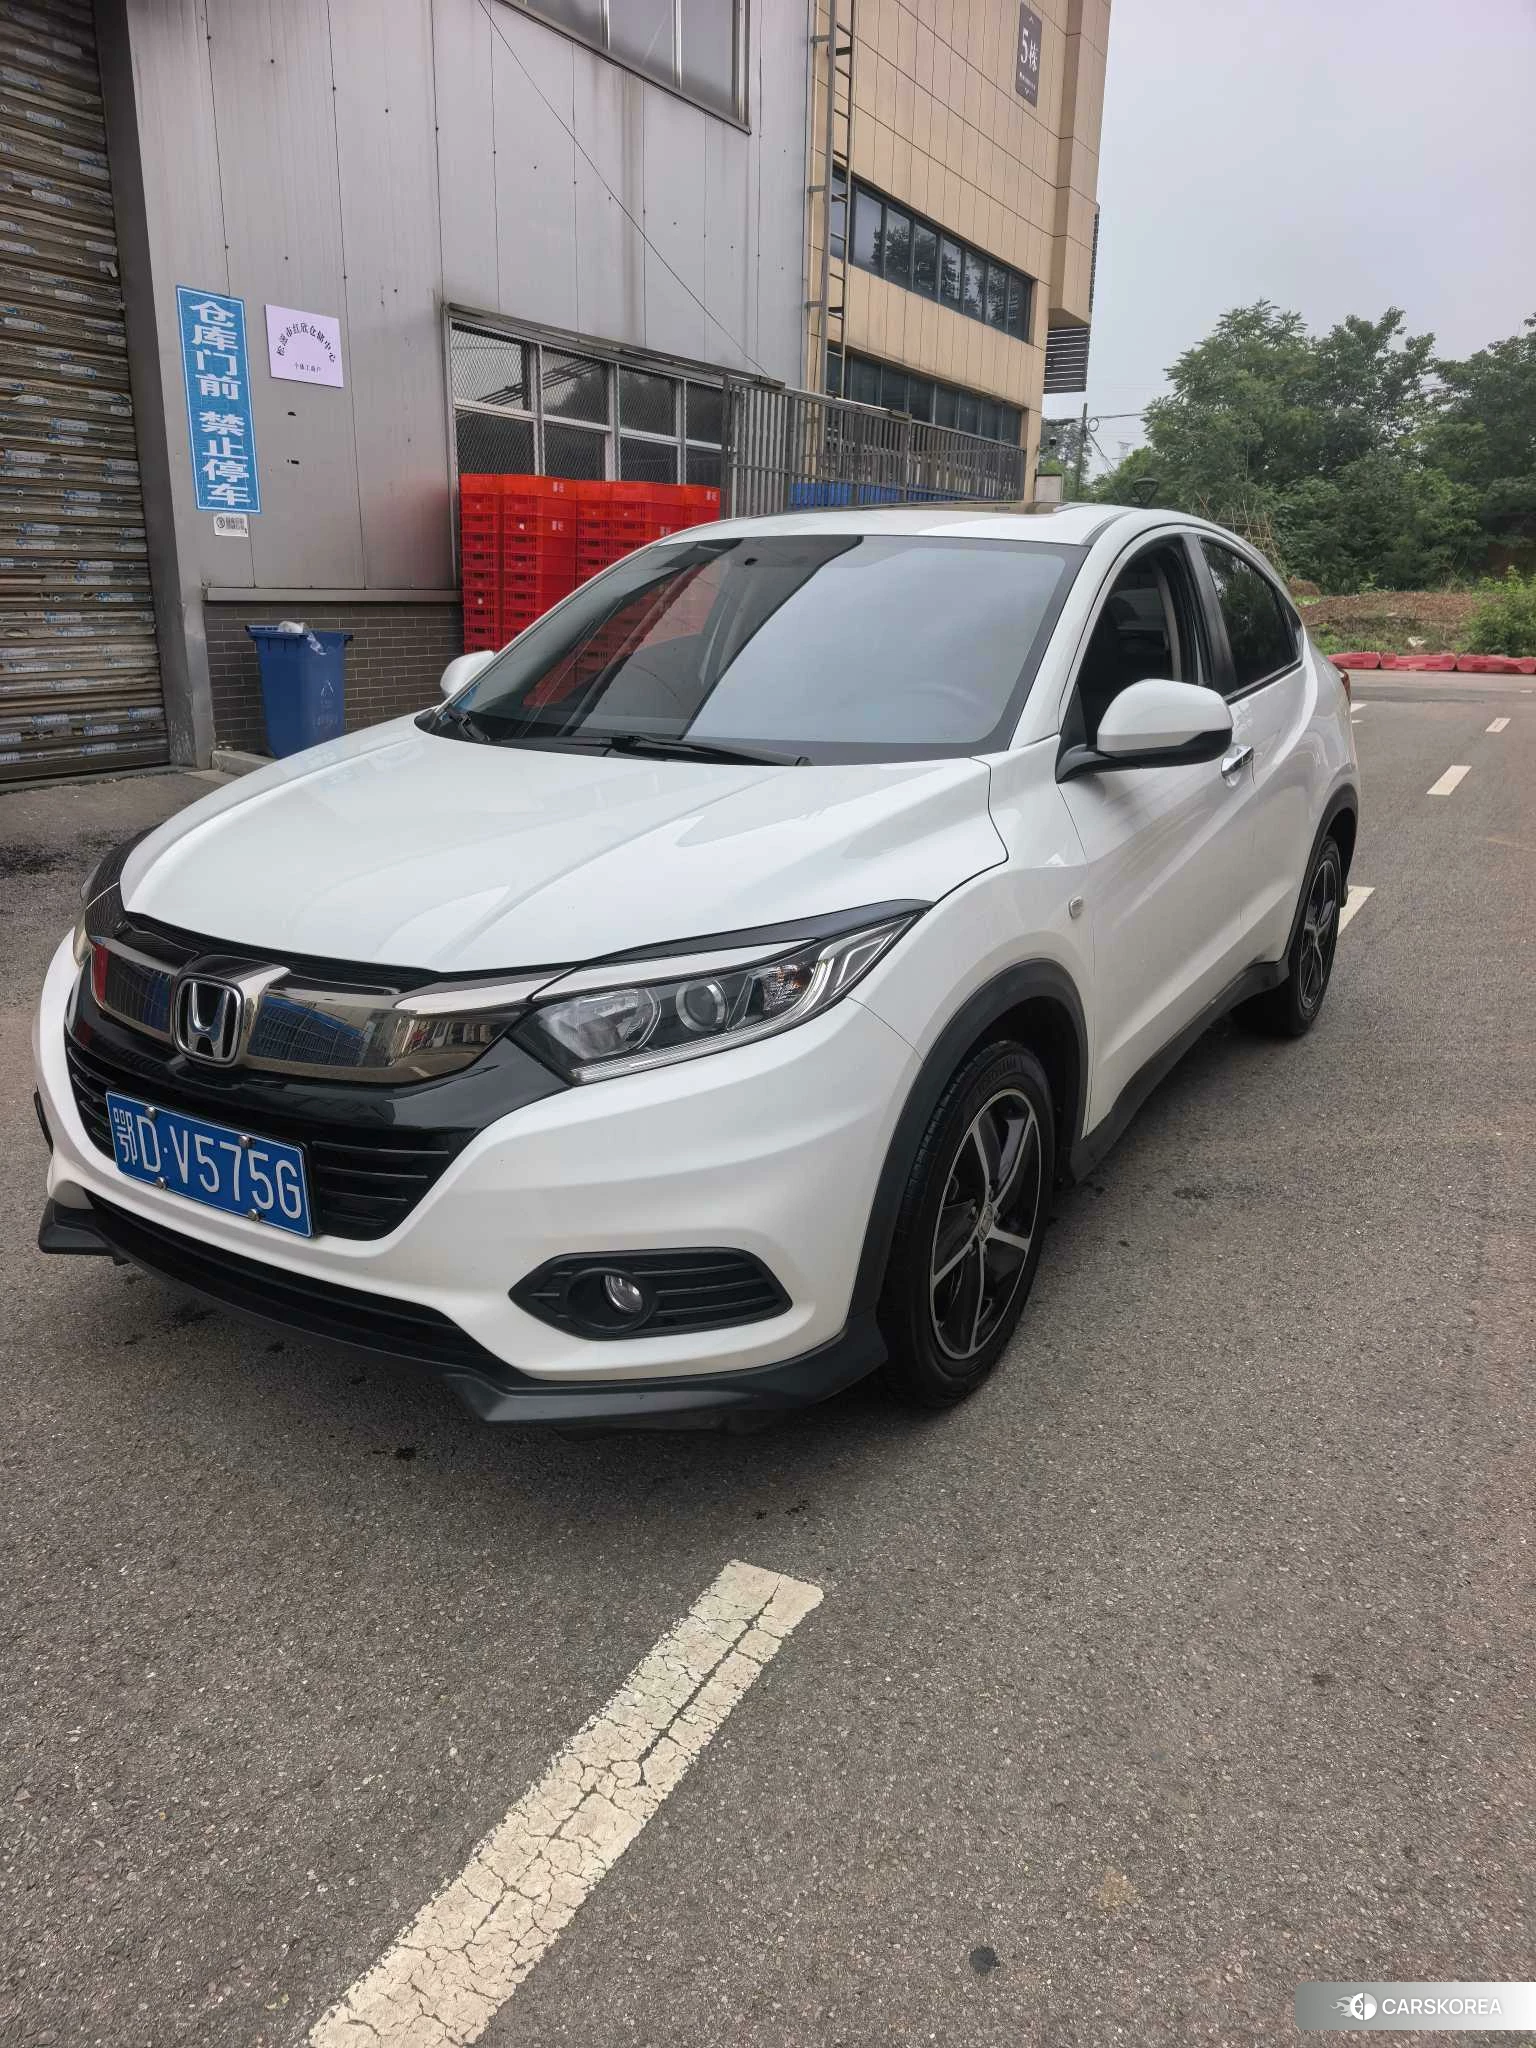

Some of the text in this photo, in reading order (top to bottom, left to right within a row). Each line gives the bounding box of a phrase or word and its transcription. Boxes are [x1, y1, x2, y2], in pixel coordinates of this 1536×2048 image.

[189, 300, 240, 400] 仓库门前
[199, 411, 251, 506] 禁止停车
